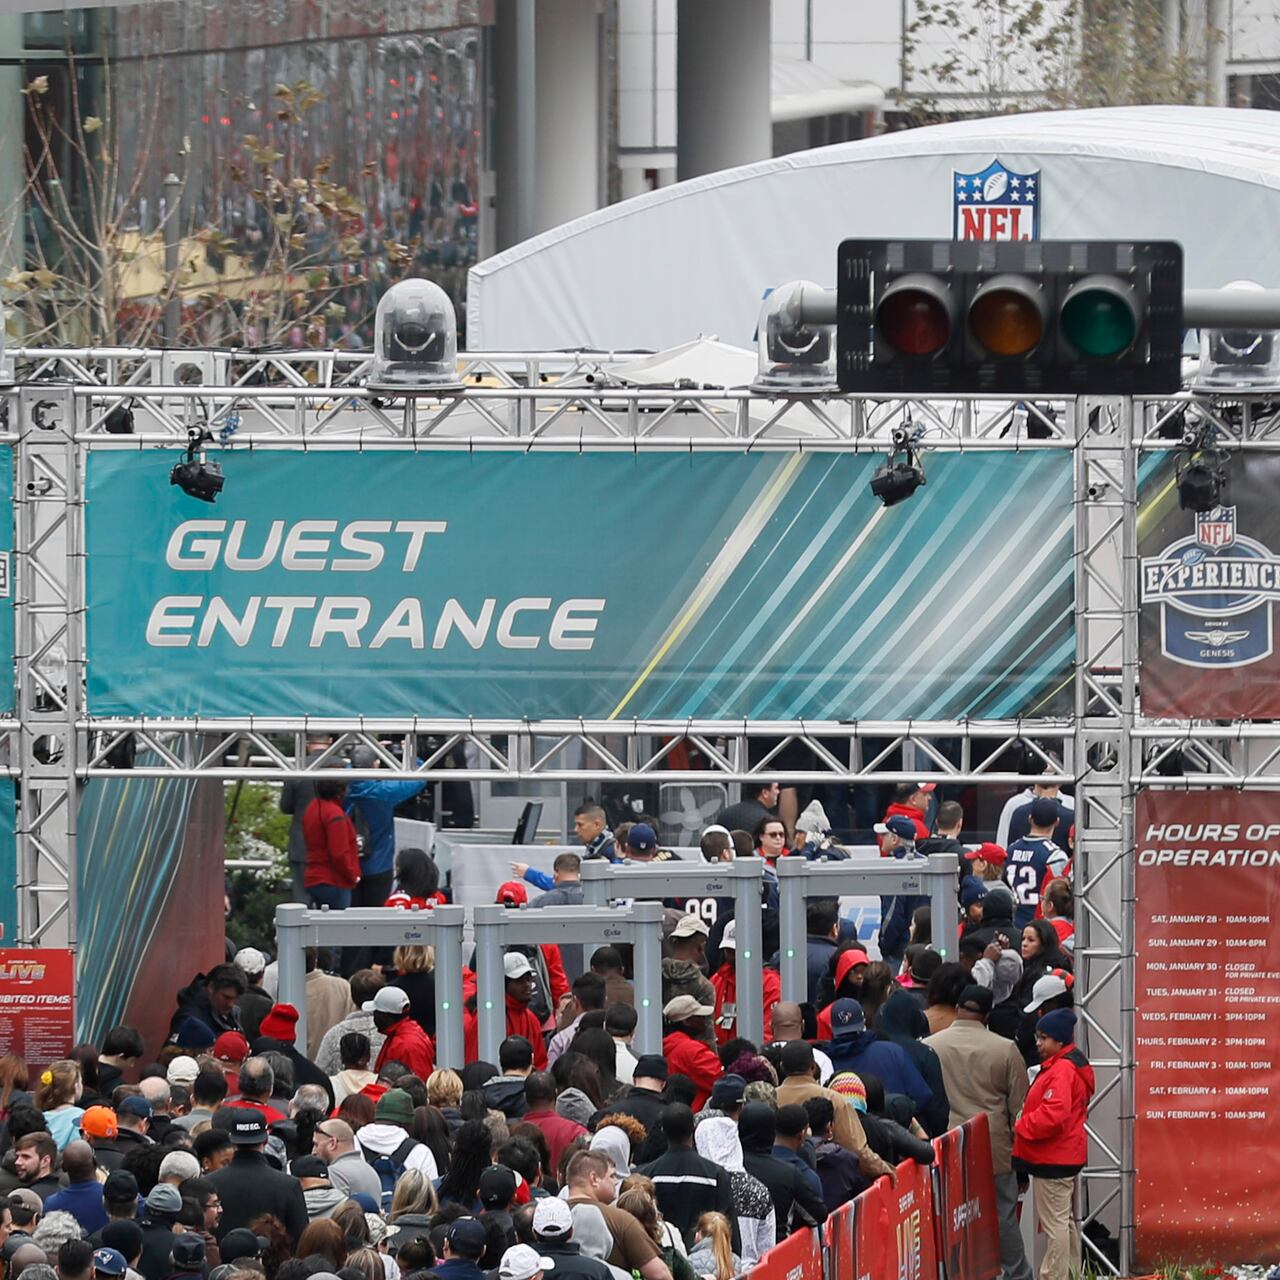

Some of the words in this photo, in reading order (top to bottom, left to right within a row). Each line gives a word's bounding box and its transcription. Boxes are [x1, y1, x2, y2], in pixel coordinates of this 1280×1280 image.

[962, 208, 1029, 241] NFL
[1199, 523, 1232, 544] NFL
[165, 519, 448, 572] GUEST
[144, 595, 607, 650] ENTRANCE
[1200, 649, 1235, 657] GENESIS
[1145, 823, 1240, 842] HOURS
[1169, 915, 1206, 923] JANUARY
[1206, 915, 1217, 923] 28
[1169, 939, 1206, 947] JANUARY
[1206, 939, 1217, 947] 29
[1170, 989, 1207, 997] JANUARY
[1208, 989, 1217, 997] 31
[35, 995, 71, 1004] ITEMS:
[1169, 1013, 1210, 1021] FEBRUARY
[1214, 1013, 1217, 1021] 1
[1167, 1087, 1210, 1095] FEBRUARY
[1210, 1087, 1217, 1095] 4
